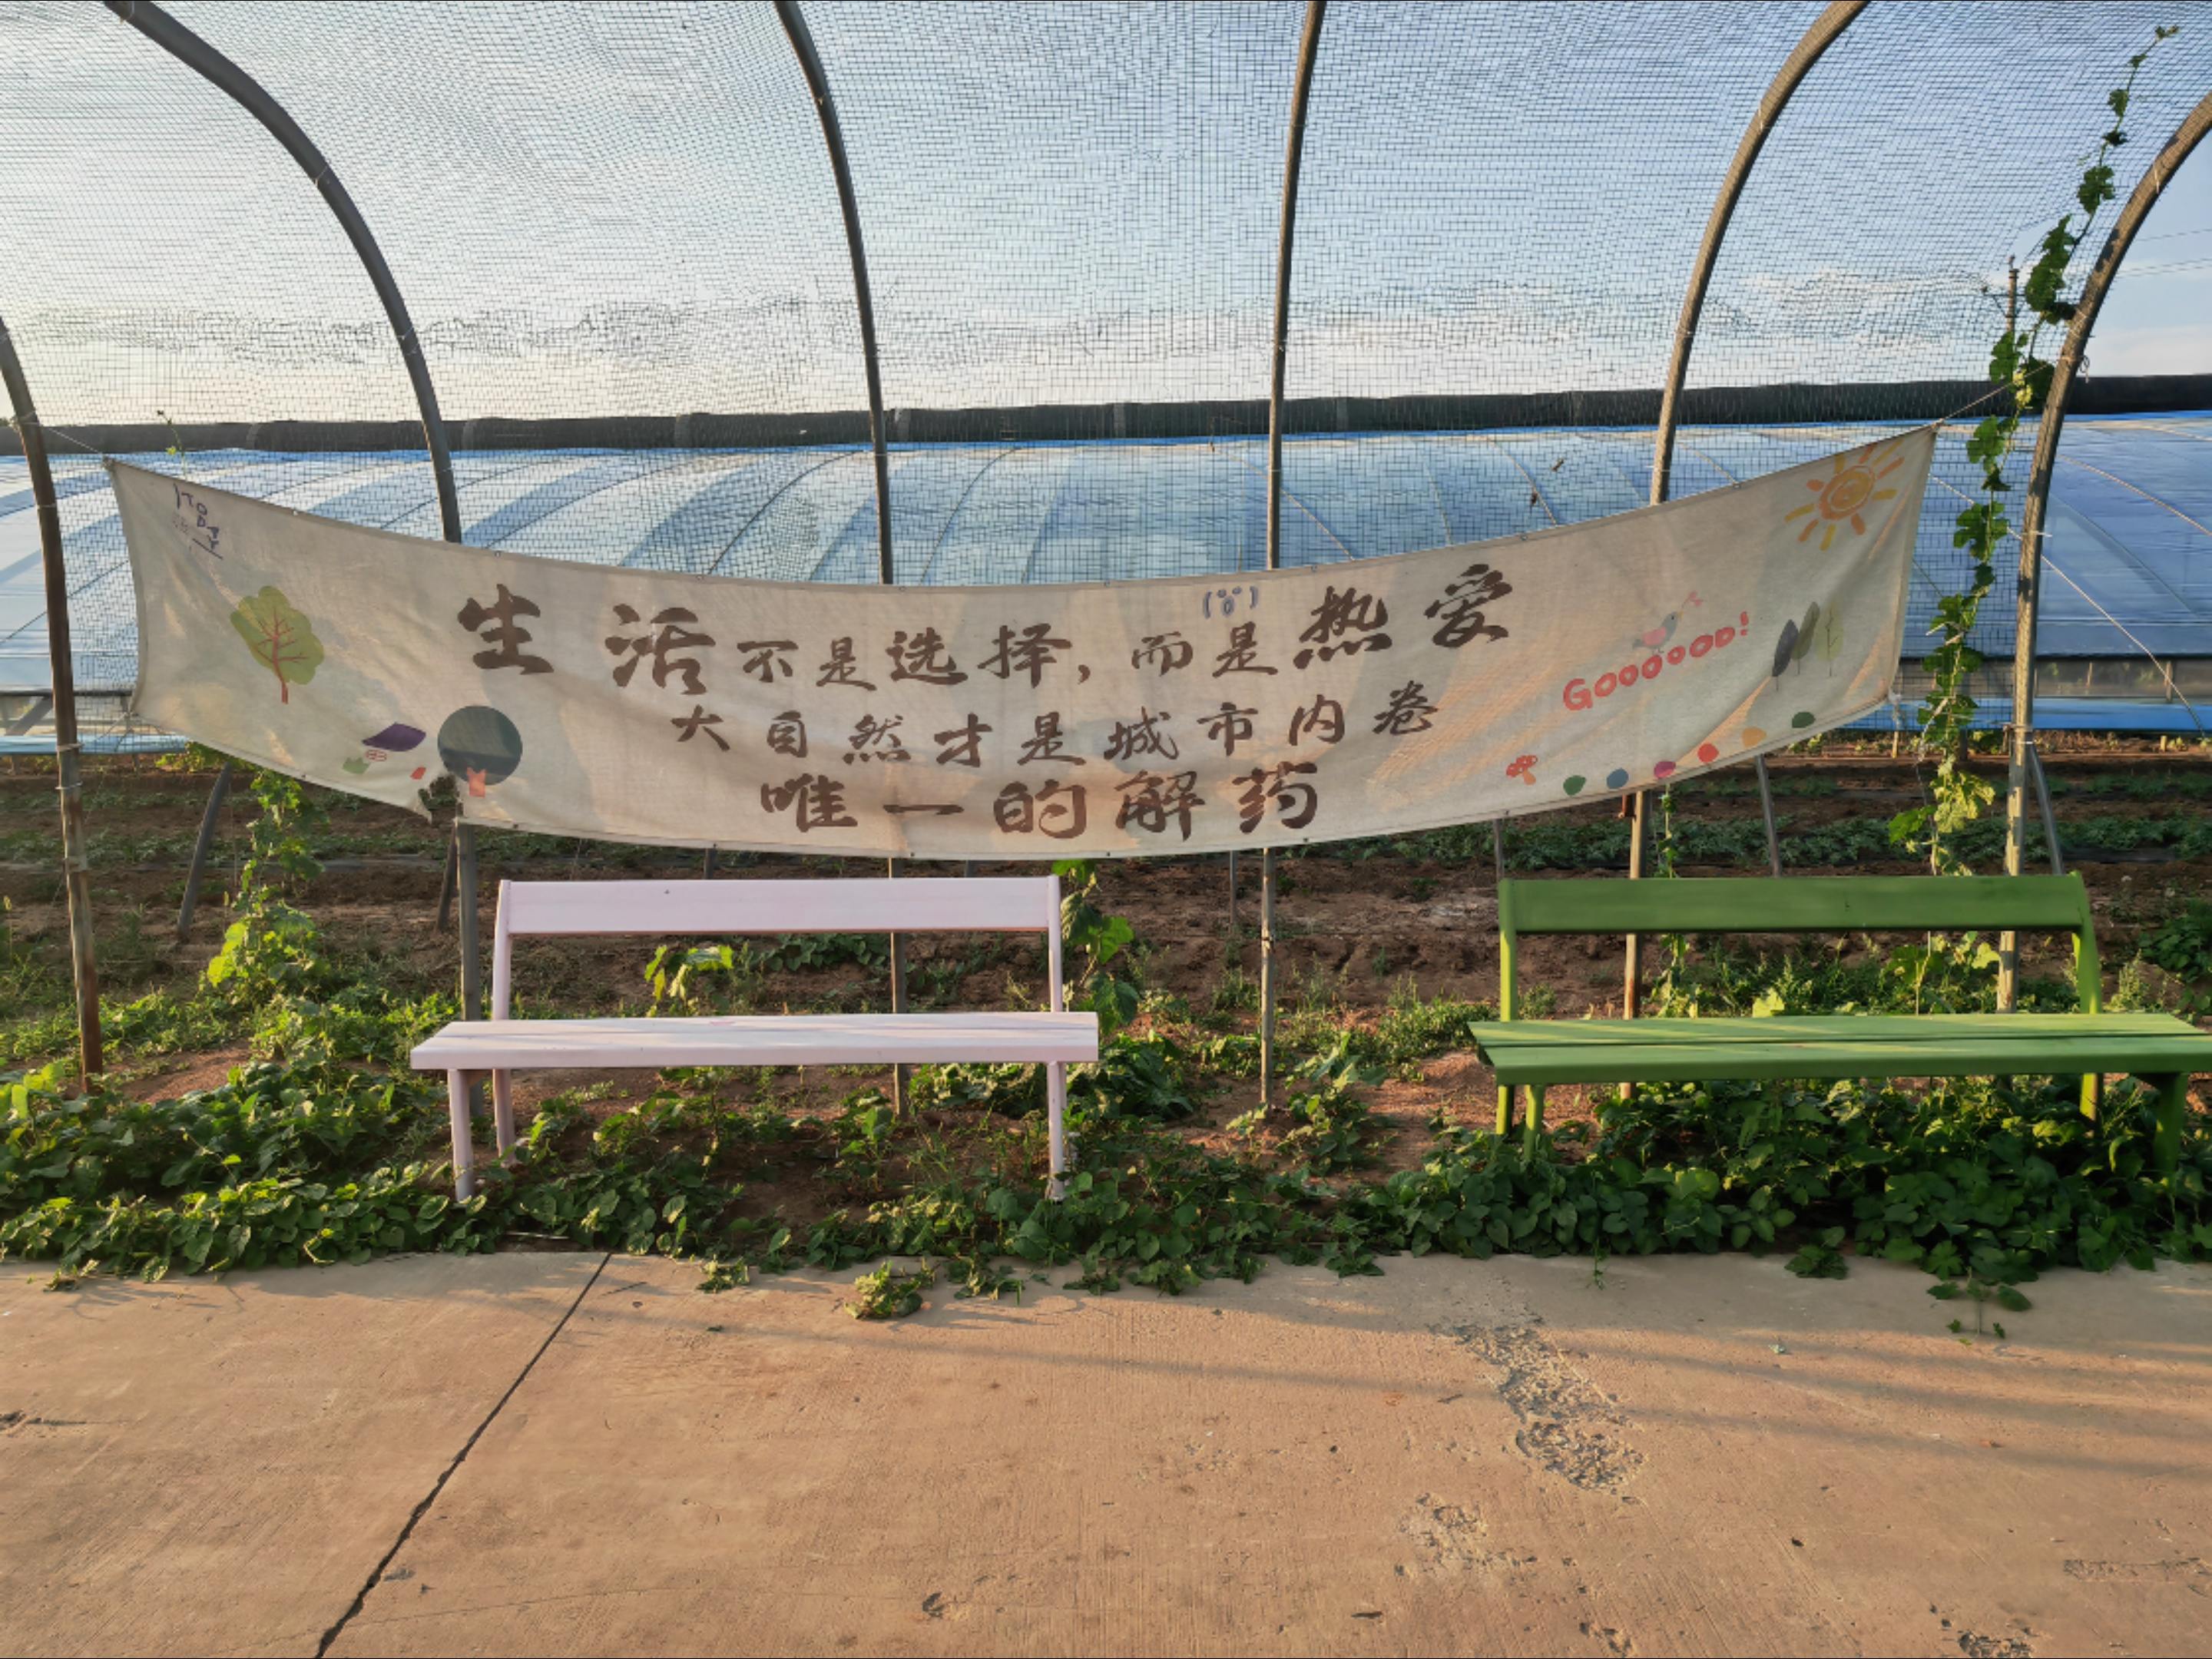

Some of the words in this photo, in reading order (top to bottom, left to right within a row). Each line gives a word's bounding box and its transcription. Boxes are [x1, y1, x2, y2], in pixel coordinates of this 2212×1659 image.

[672, 680, 1438, 767] 大自然才是城市内卷
[760, 762, 1318, 841] 唯一的解药
